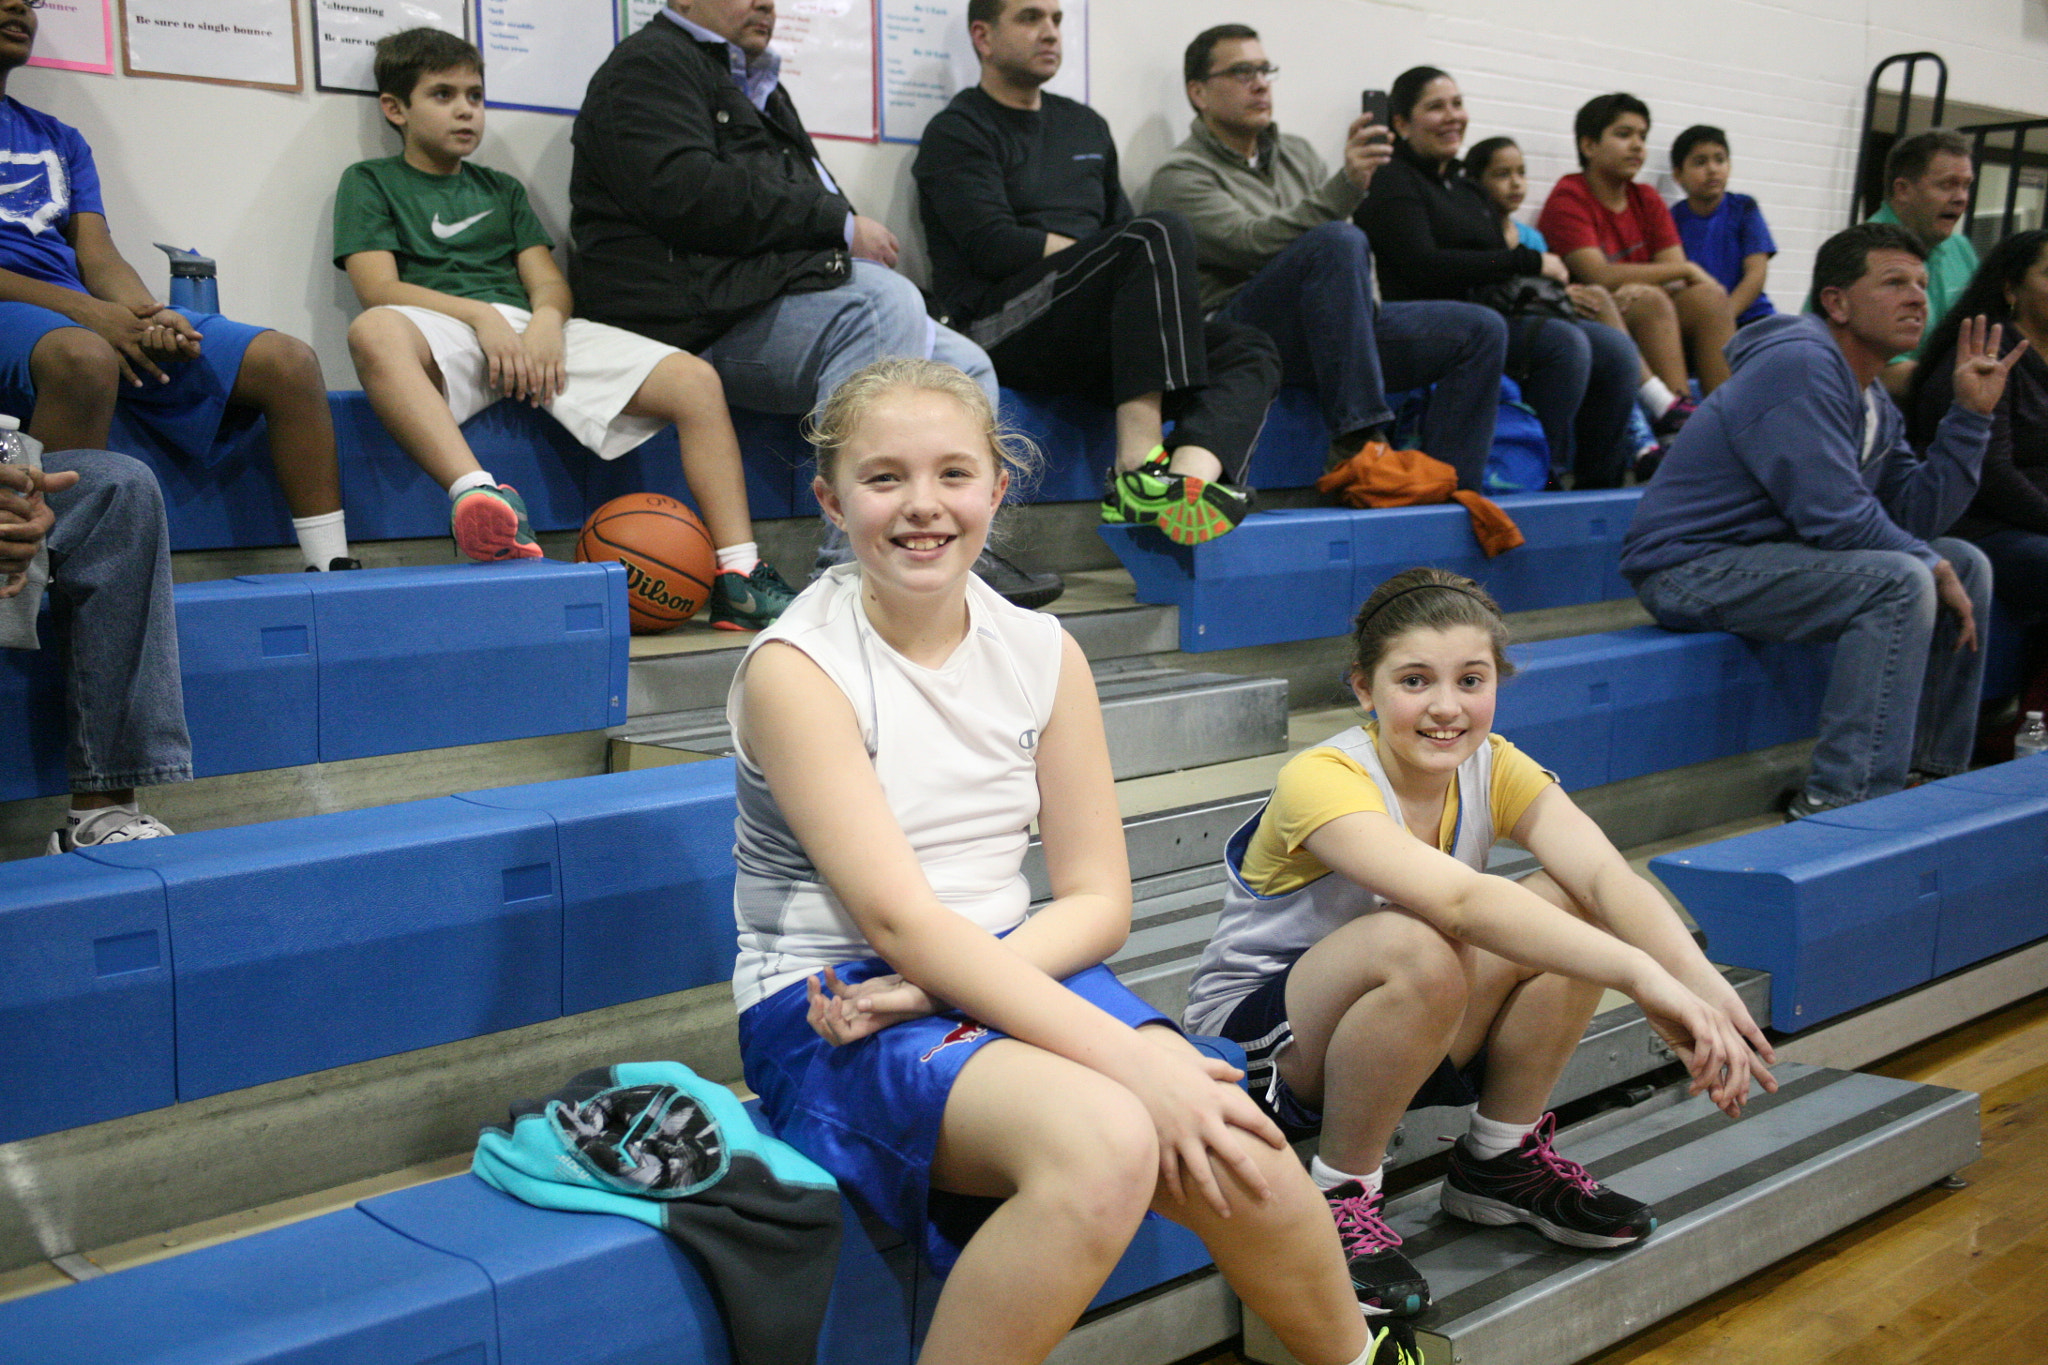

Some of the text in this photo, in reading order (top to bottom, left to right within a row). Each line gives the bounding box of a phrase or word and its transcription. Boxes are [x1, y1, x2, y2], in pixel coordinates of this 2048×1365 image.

[135, 15, 273, 37] Be sure to single bounce
[618, 556, 694, 613] Wilson
